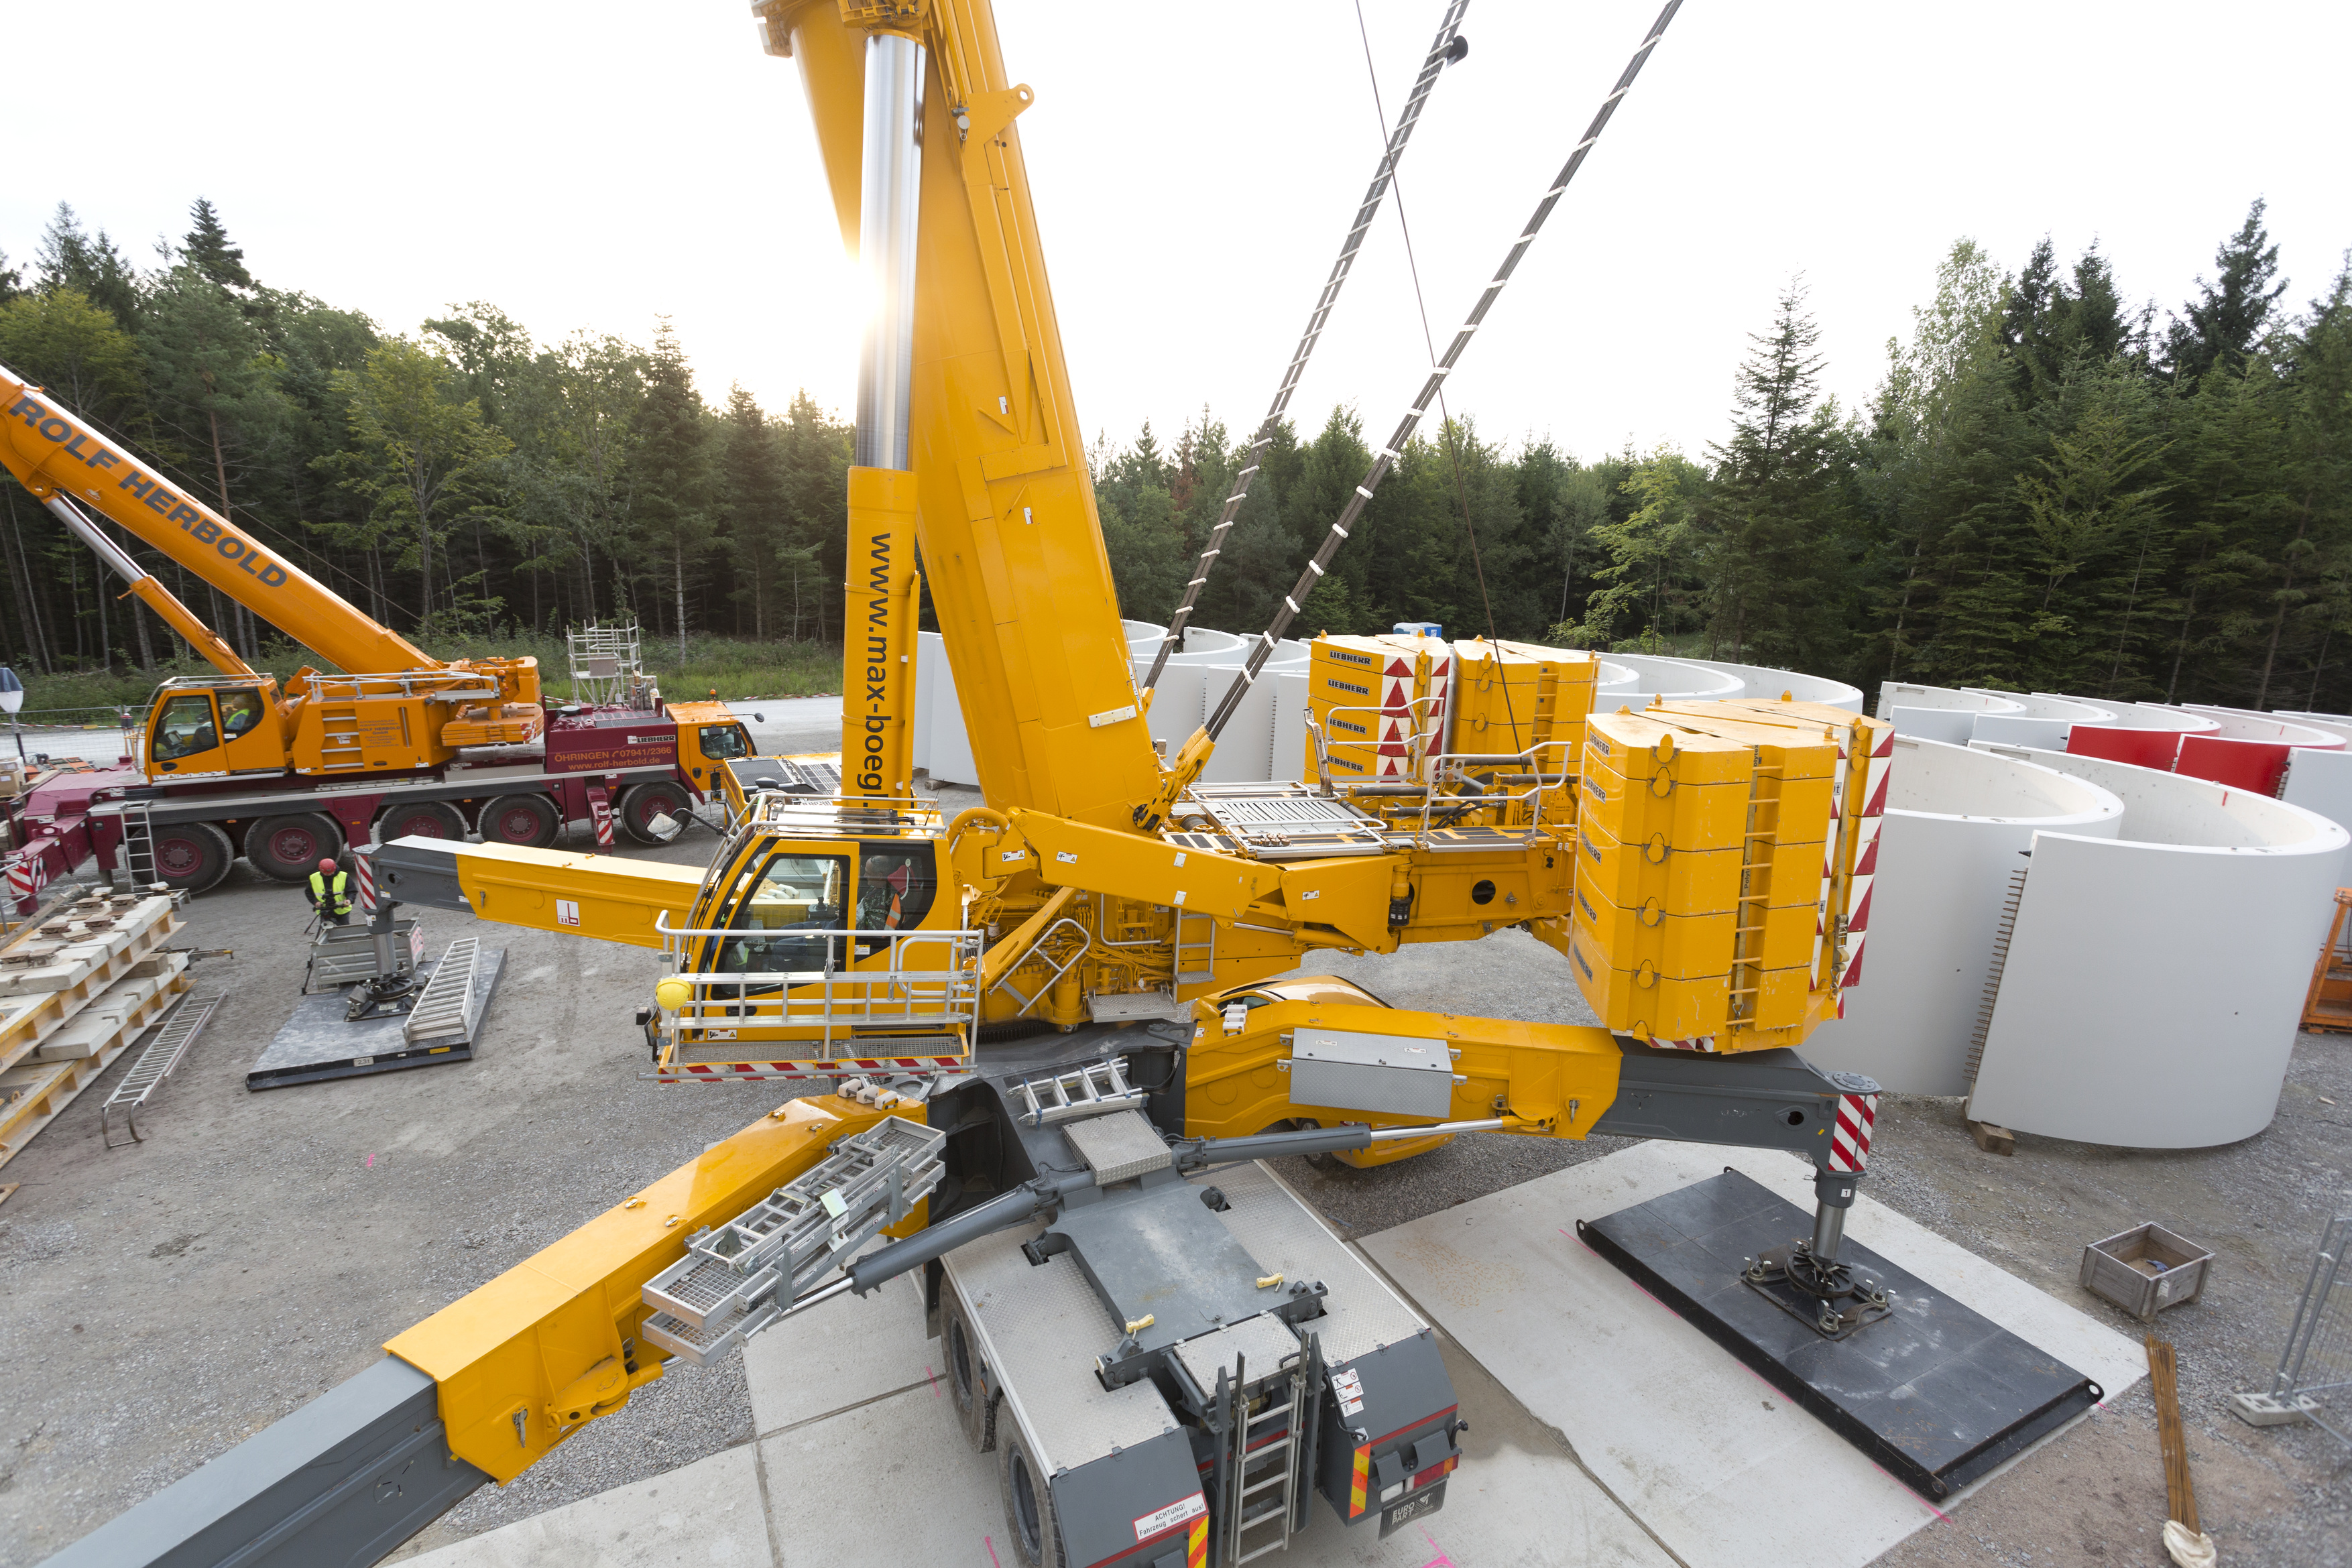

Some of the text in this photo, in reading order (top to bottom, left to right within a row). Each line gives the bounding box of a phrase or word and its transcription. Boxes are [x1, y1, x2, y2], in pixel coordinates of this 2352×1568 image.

[8, 397, 288, 587] ROLF HERBOLD
[1330, 651, 1371, 665] LIEBHERR
[1328, 679, 1368, 695] LIEBHERR
[1590, 732, 1609, 756] LIEBHERR
[554, 747, 672, 762] ÖHRINGEN 07941/2366
[569, 757, 660, 770] www.rolf-herbold.de
[1328, 755, 1363, 772] IEBHERR
[1586, 776, 1606, 802] LIEBHERR
[1155, 1504, 1185, 1521] ACHTUNG!
[1392, 1508, 1414, 1525] PART
[1393, 1502, 1415, 1518] EURO
[1139, 1503, 1204, 1536] Fahrzeug schert aus!
